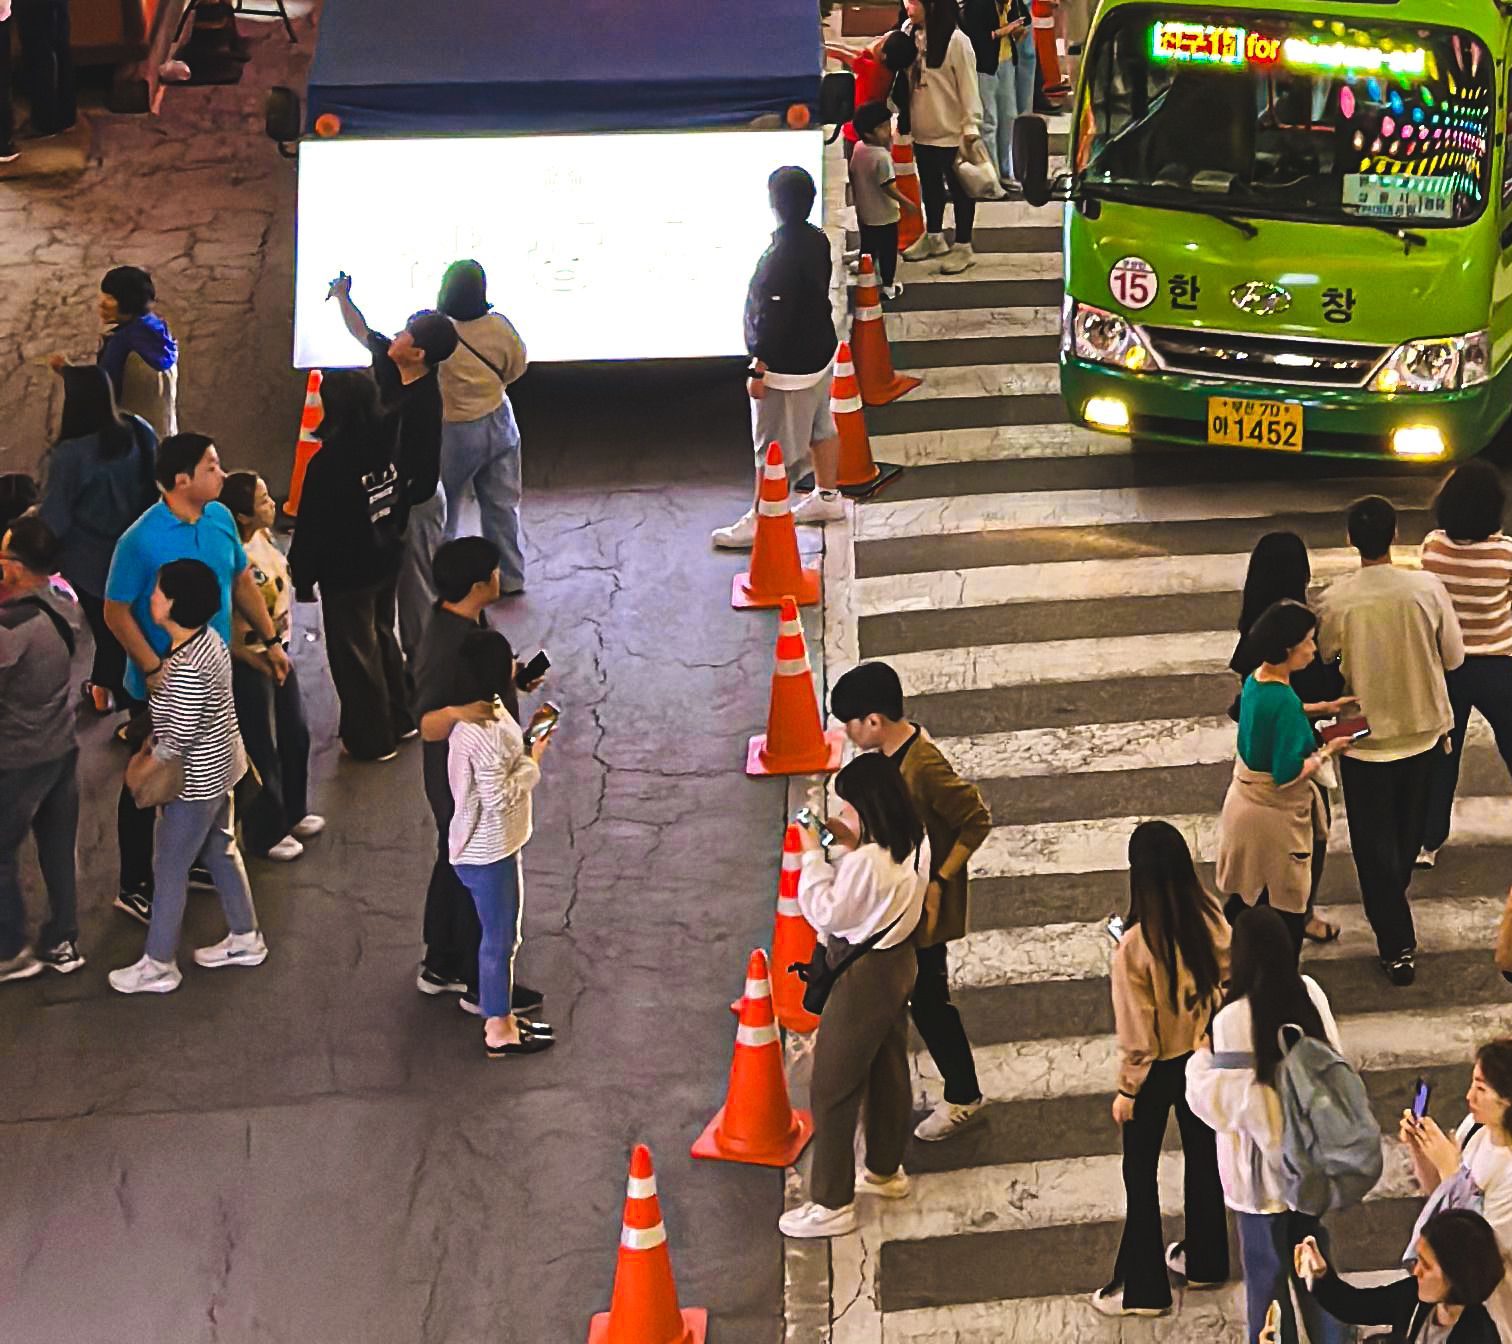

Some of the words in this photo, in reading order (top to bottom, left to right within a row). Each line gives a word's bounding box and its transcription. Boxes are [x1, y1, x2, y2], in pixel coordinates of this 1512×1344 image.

[1247, 32, 1280, 60] for
[1113, 271, 1149, 305] 15
[1167, 273, 1201, 310] 한
[1321, 287, 1356, 324] 창
[1233, 417, 1298, 447] 1452
